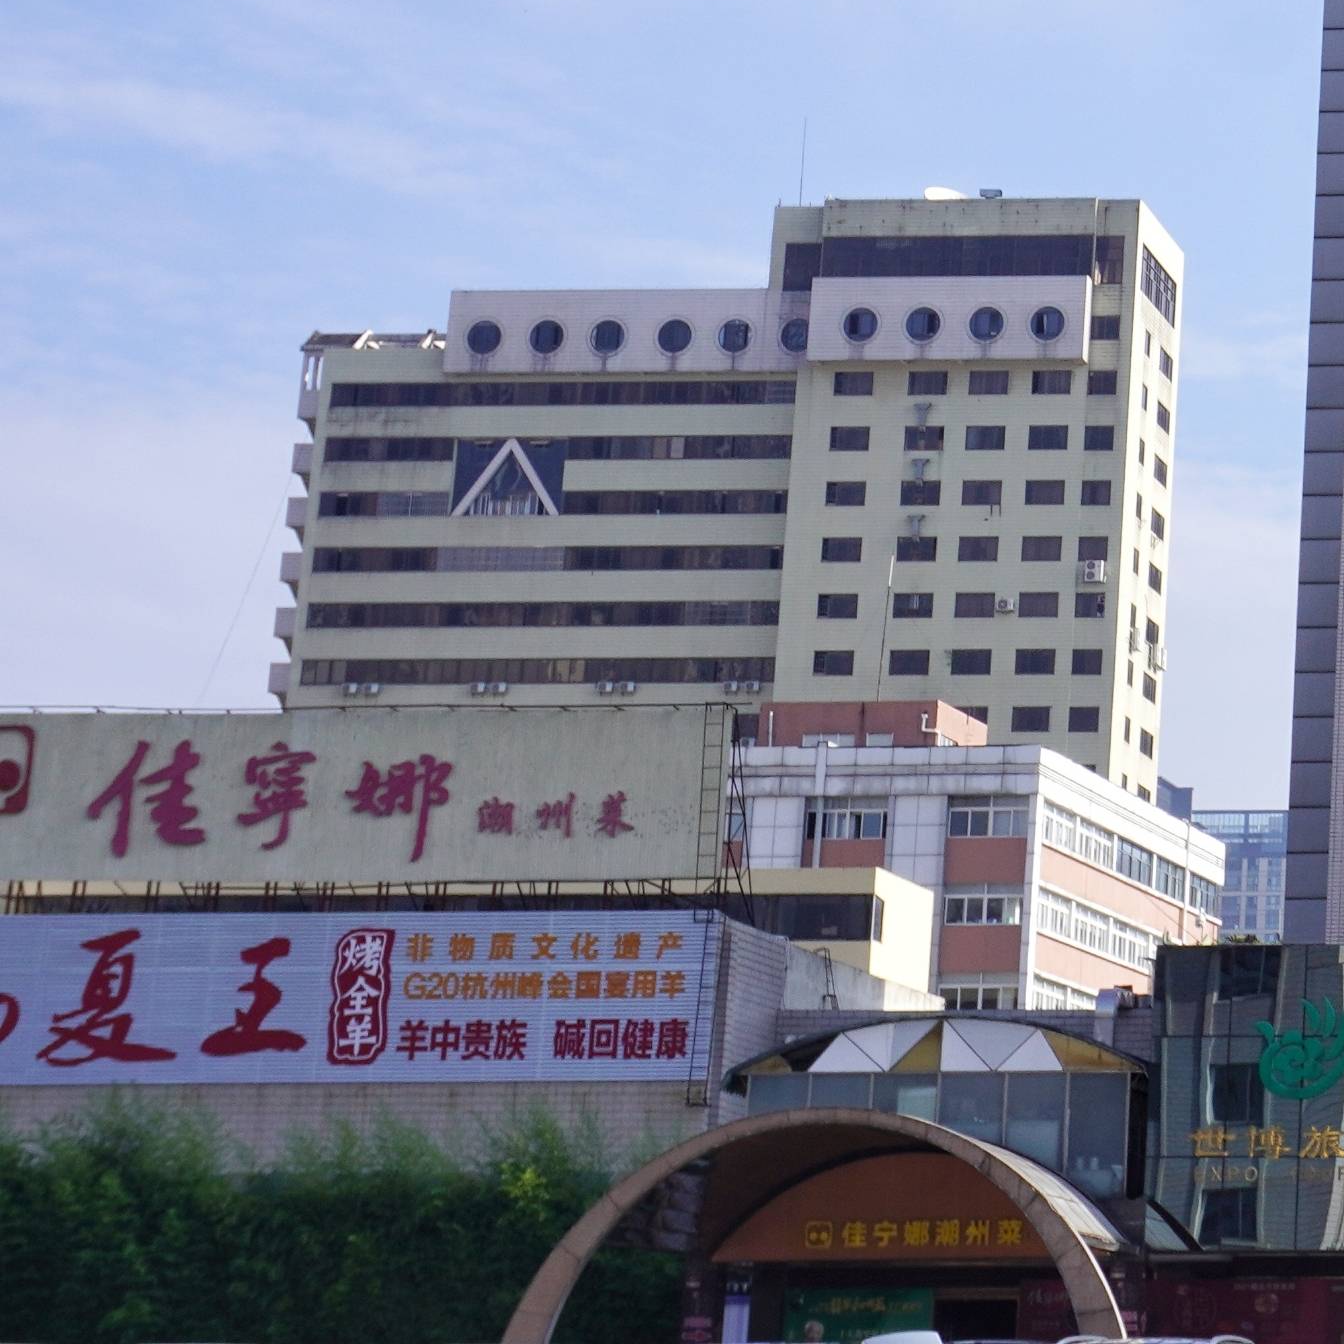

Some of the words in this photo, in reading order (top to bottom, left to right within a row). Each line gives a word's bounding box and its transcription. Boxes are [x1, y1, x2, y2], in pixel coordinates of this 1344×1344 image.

[406, 930, 684, 962] 非物质文化遗产
[0, 929, 307, 1067] 夏王
[339, 934, 384, 1056] 烤全羊
[402, 970, 686, 1000] G20杭州峰会国宴用羊
[396, 1019, 528, 1060] 羊中贵族
[553, 1018, 690, 1060] 碱回健康
[842, 1219, 1023, 1248] 佳宁娜潮州菜
